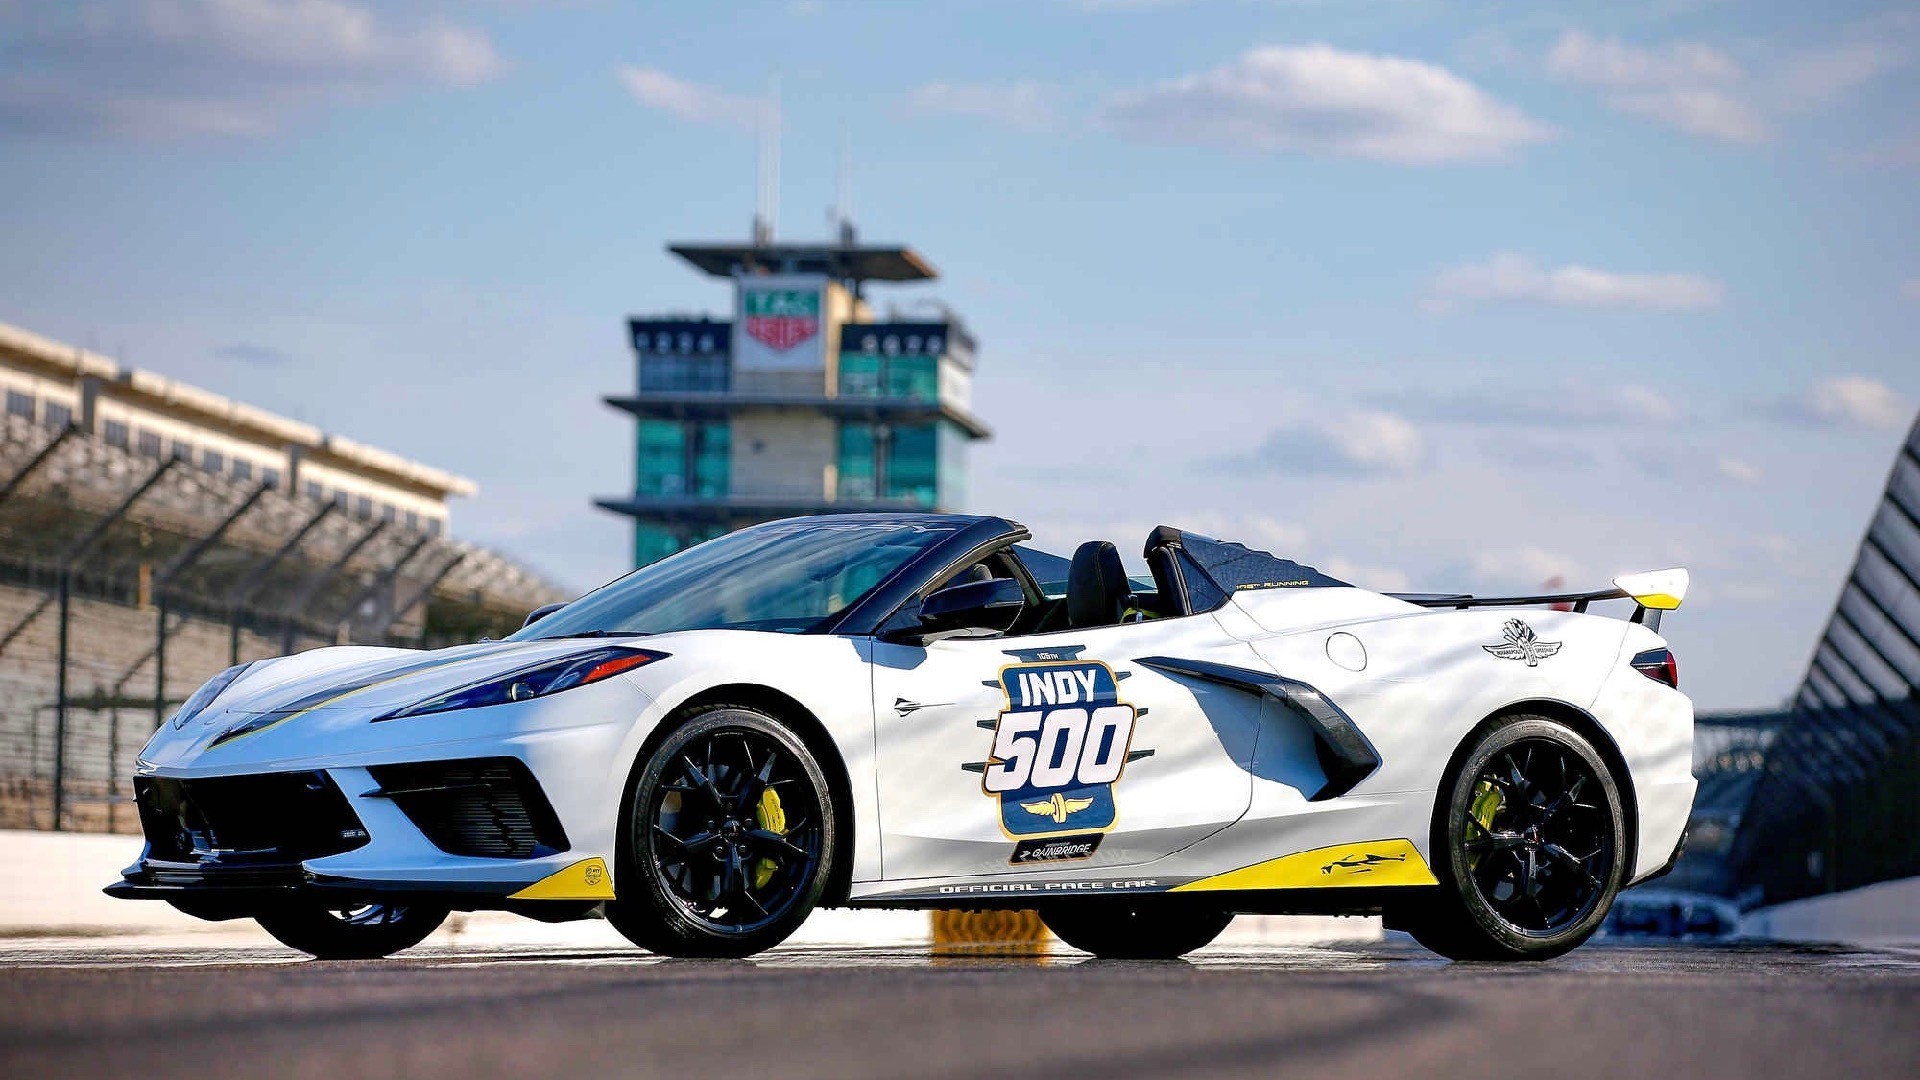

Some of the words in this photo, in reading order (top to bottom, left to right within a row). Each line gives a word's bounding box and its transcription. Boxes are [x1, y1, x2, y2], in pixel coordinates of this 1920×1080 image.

[1037, 652, 1059, 660] 105TH
[1018, 669, 1096, 707] INDY
[985, 706, 1134, 792] 500
[1032, 843, 1091, 858] GAINBRIDGE
[939, 883, 1039, 894] OFFICIAL
[1045, 882, 1104, 890] PACE
[1111, 880, 1158, 889] CAR
